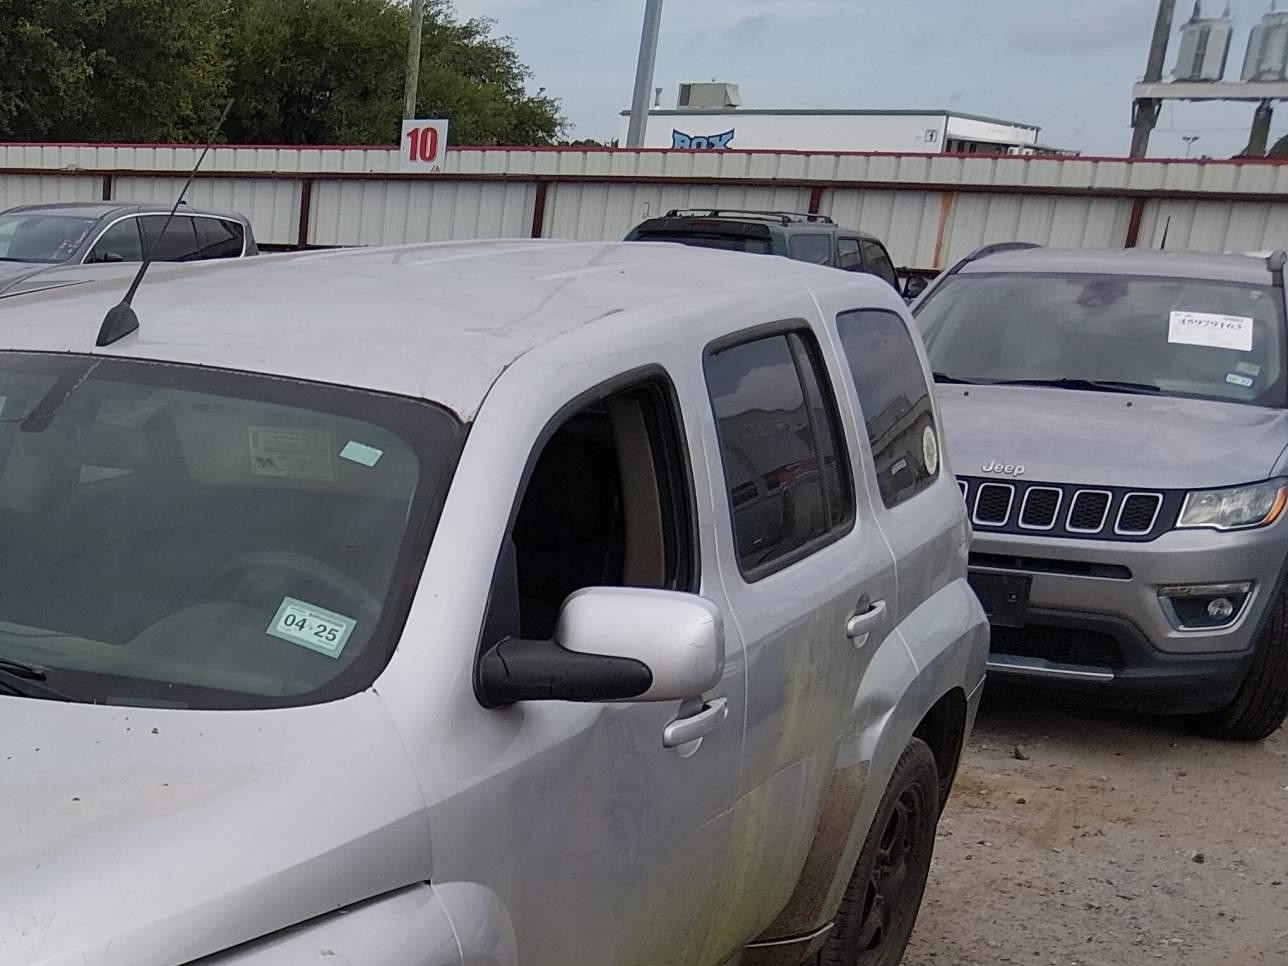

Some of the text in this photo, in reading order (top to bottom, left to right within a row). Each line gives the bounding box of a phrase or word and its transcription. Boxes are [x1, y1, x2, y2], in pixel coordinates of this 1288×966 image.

[407, 127, 438, 162] 10
[982, 460, 1025, 477] Jeep
[283, 614, 307, 632] 04
[314, 623, 339, 642] 25
